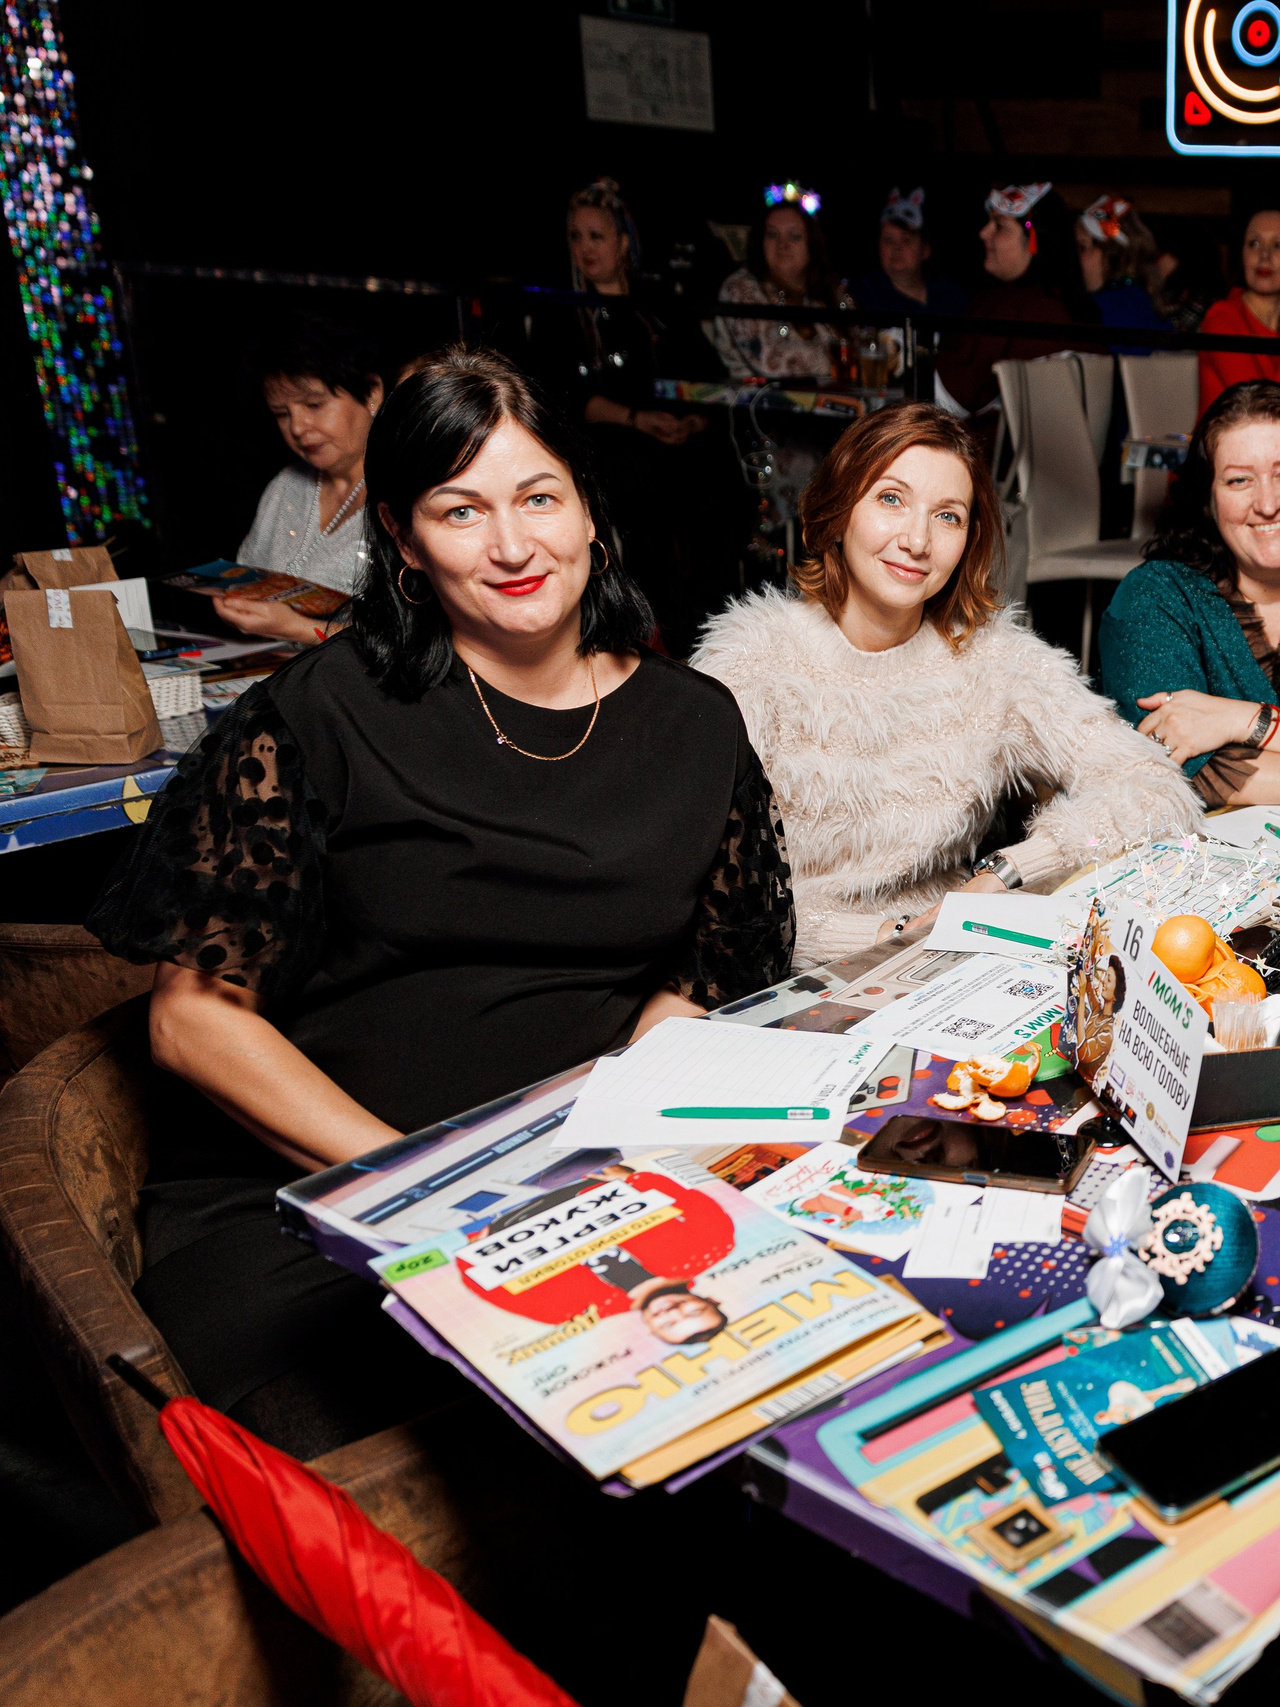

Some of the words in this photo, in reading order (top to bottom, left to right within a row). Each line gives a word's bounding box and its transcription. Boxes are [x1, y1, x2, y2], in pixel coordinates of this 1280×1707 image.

[1123, 918, 1144, 962] 16
[1118, 1019, 1132, 1049] НА
[1133, 1034, 1155, 1071] ВСЮ
[1152, 1060, 1191, 1110] ГОЛОВУ
[1133, 999, 1191, 1078] ВОЛШЕБНЫЕ
[475, 1188, 628, 1257] ЖУКОВ
[492, 1200, 649, 1275] СЕРГЕЙ
[631, 1211, 667, 1231] ЧТО
[517, 1229, 632, 1284] ПРИГОТОВИЛ
[540, 1346, 634, 1398] РИЖСКОЕ
[565, 1269, 880, 1436] МЕНЮ
